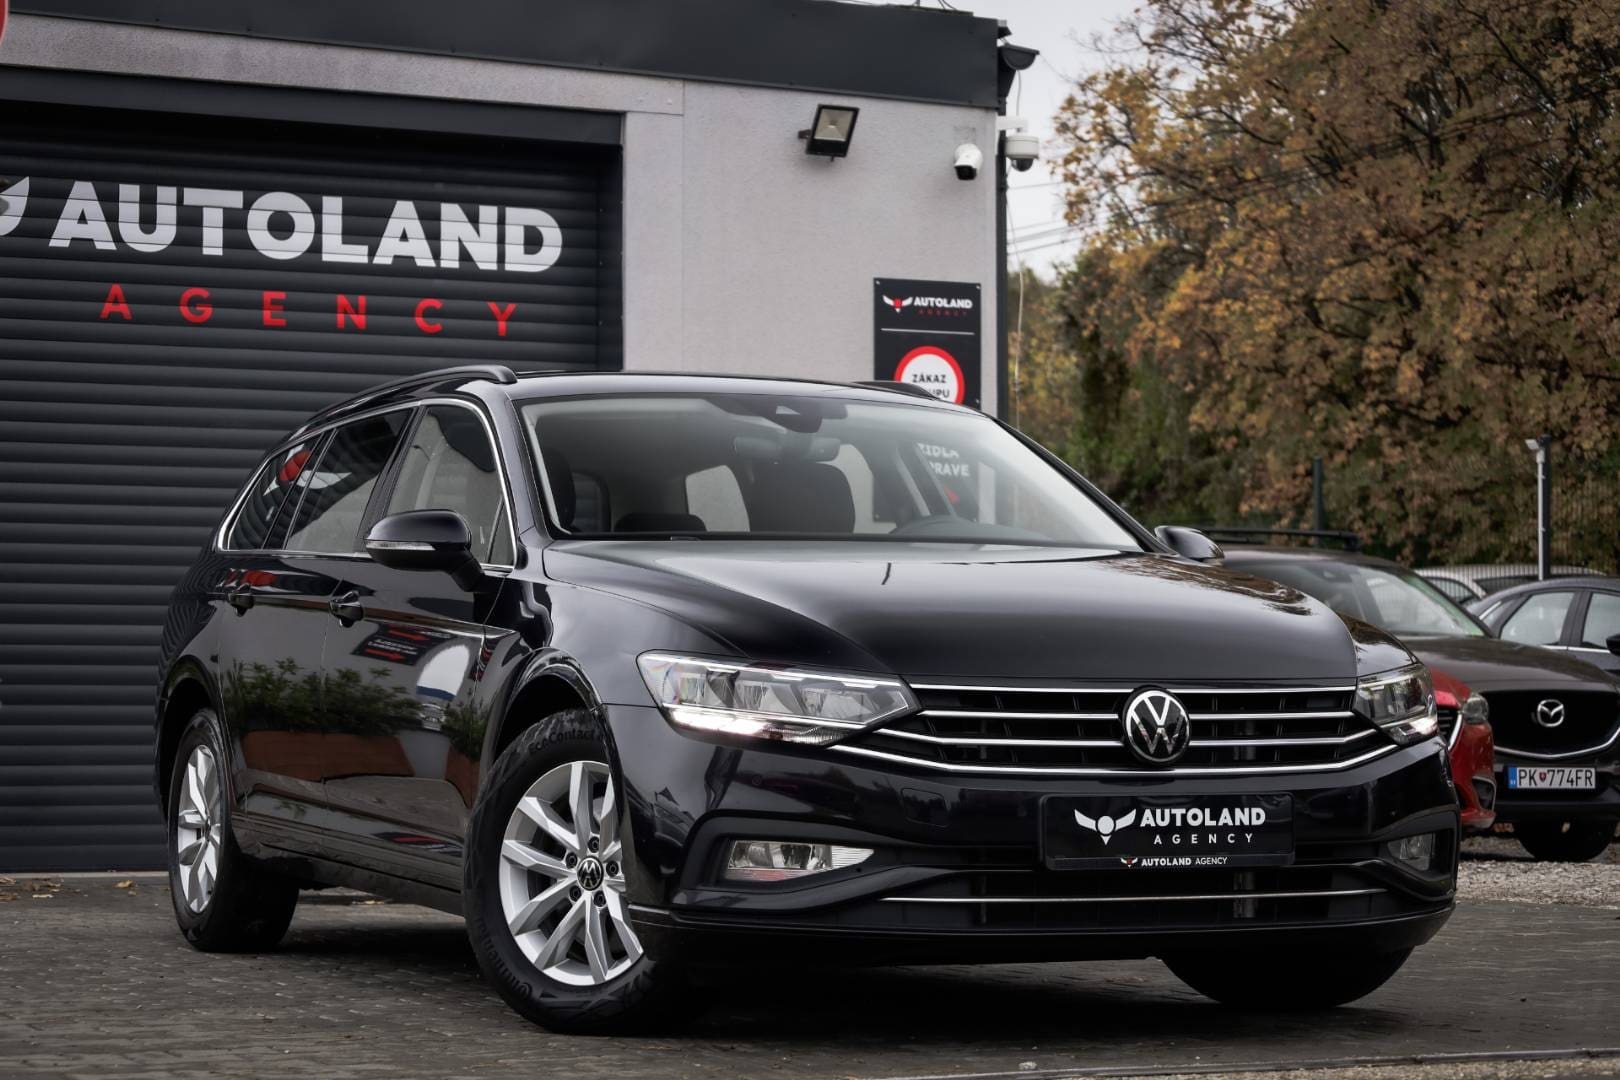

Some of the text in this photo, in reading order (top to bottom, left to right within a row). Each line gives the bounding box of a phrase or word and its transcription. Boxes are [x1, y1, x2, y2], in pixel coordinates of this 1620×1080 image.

[48, 180, 563, 273] AUTOLAND
[100, 283, 517, 337] AGENCY
[913, 296, 973, 309] AUTOLAND
[1518, 769, 1593, 787] PK 774FR
[1140, 807, 1266, 827] AUTOLAND
[1153, 833, 1254, 845] AGENCY
[1141, 856, 1228, 867] AUTOLAND AGENCY
